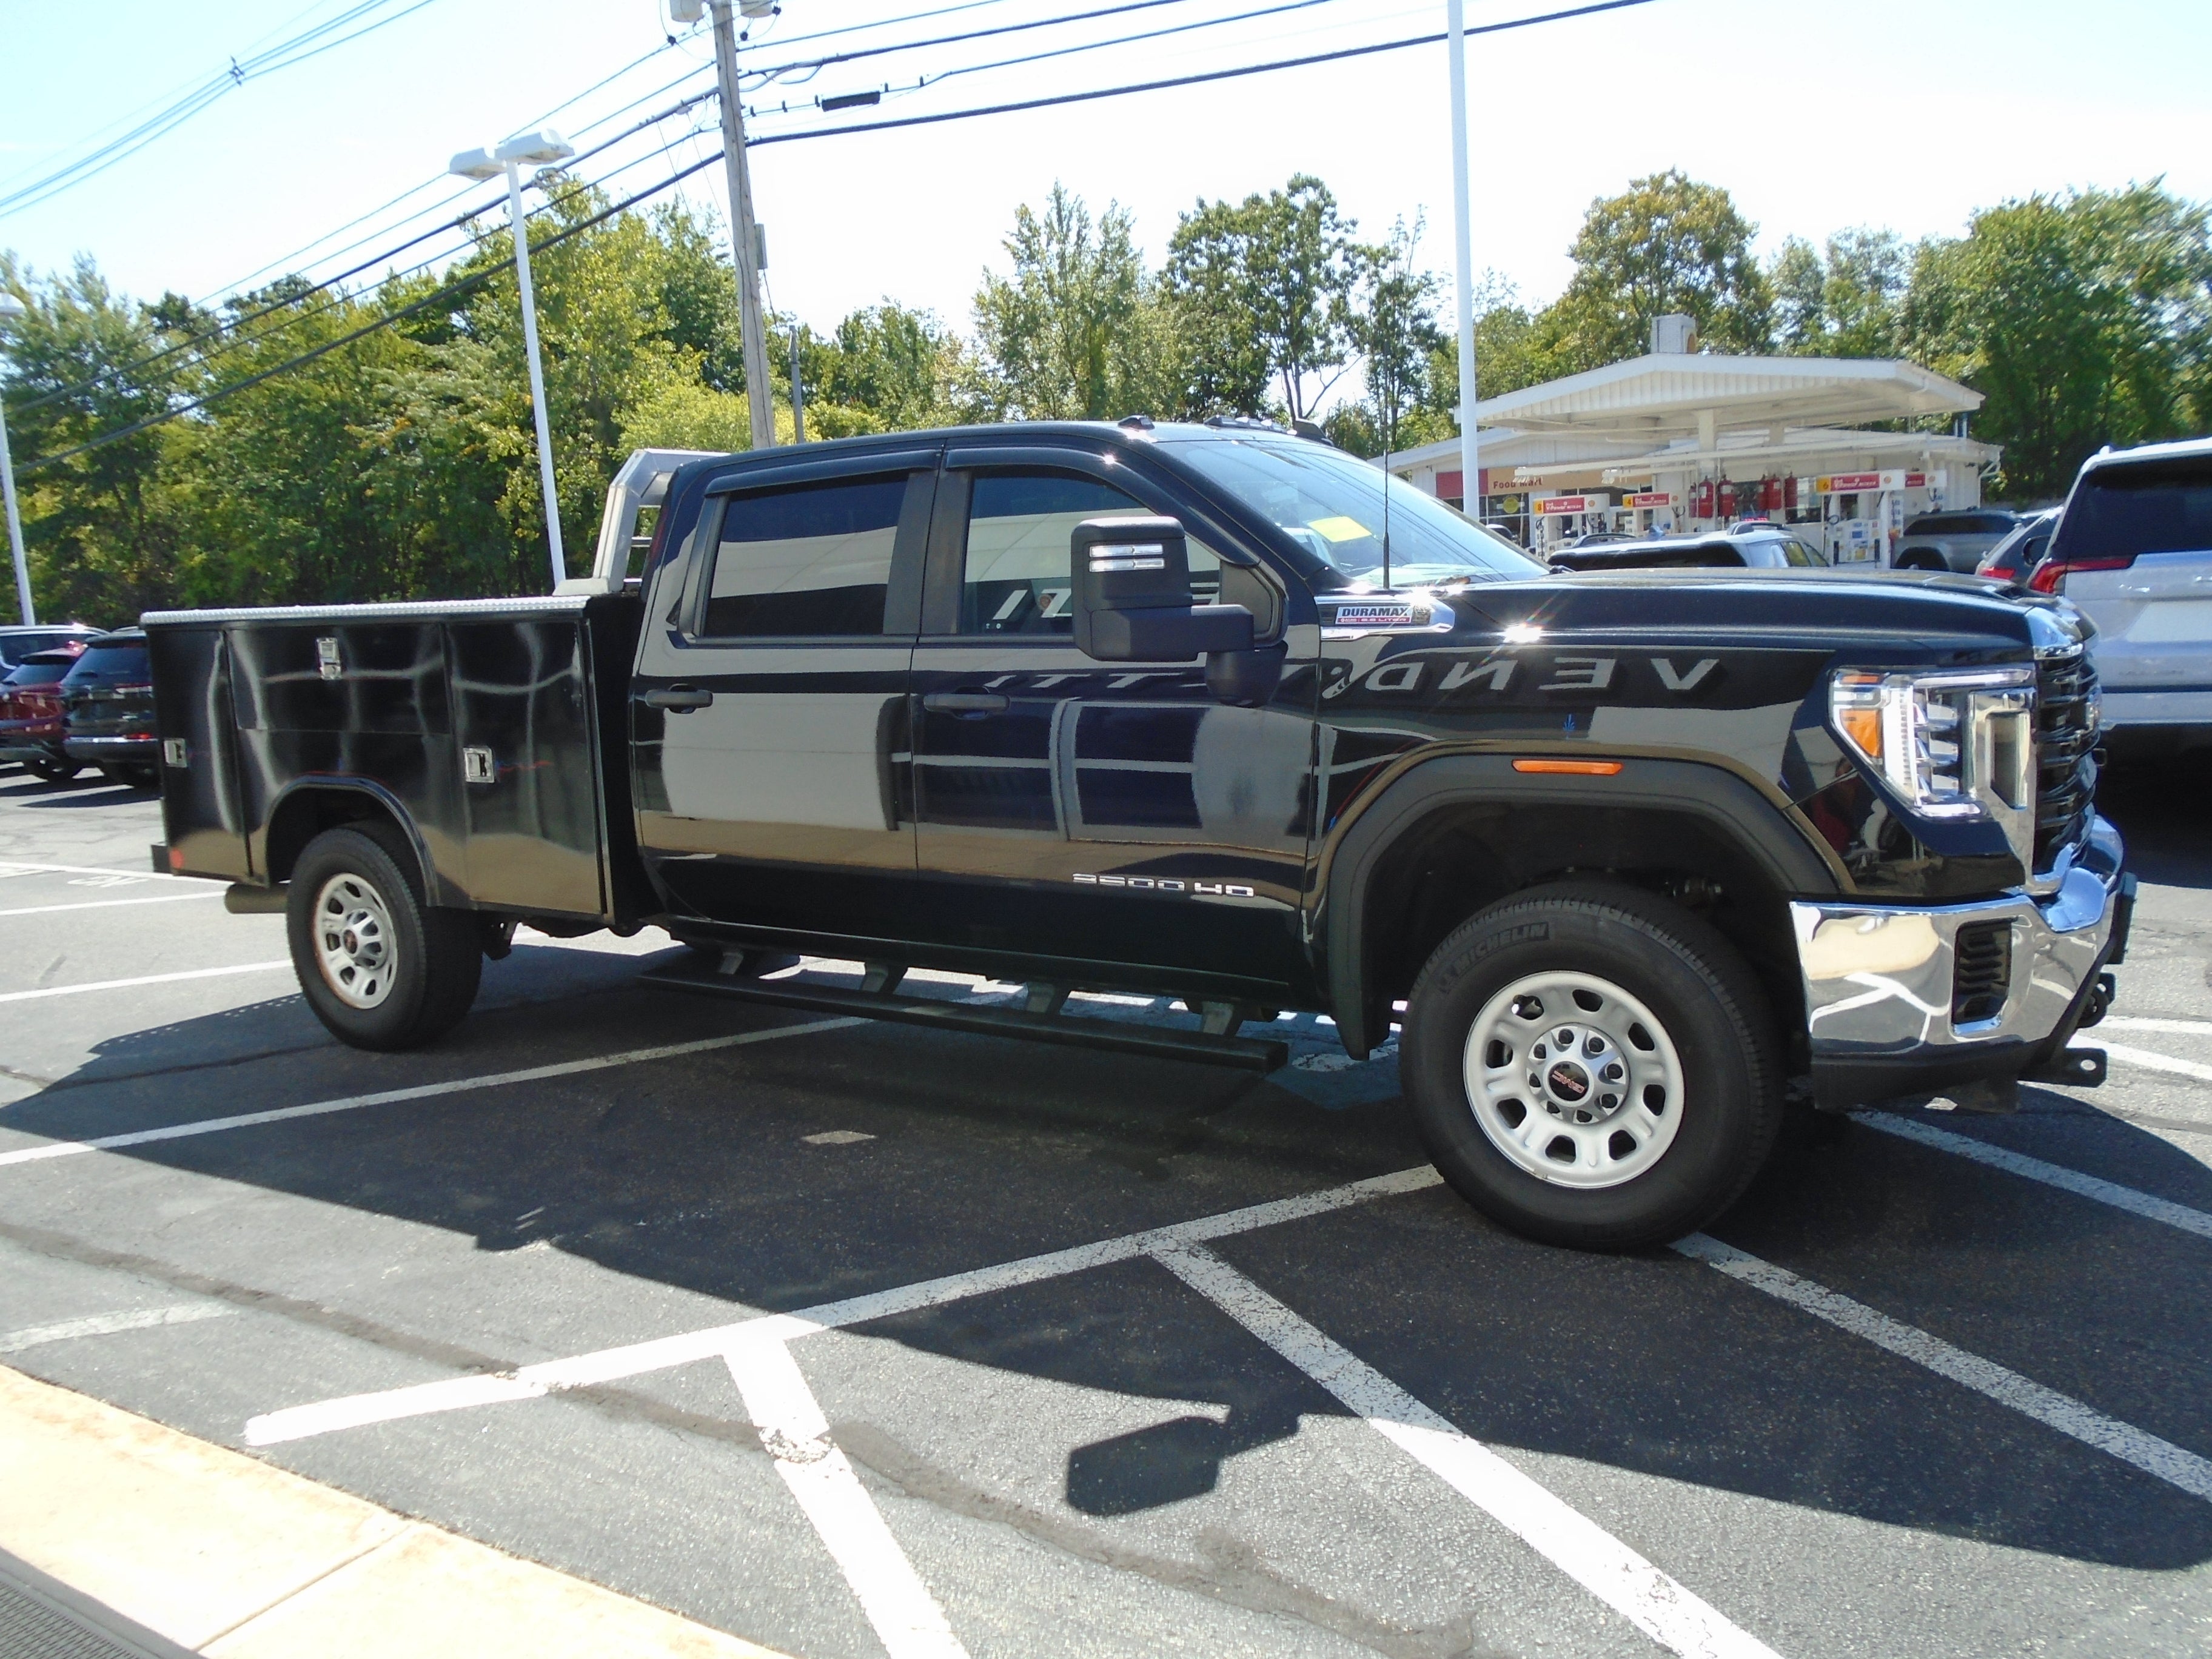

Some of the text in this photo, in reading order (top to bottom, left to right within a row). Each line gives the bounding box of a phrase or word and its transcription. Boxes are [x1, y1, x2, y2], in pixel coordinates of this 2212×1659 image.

[1342, 608, 1408, 617] DURAMAX
[1194, 882, 1255, 897] HD
[1551, 1070, 1585, 1094] GMC
